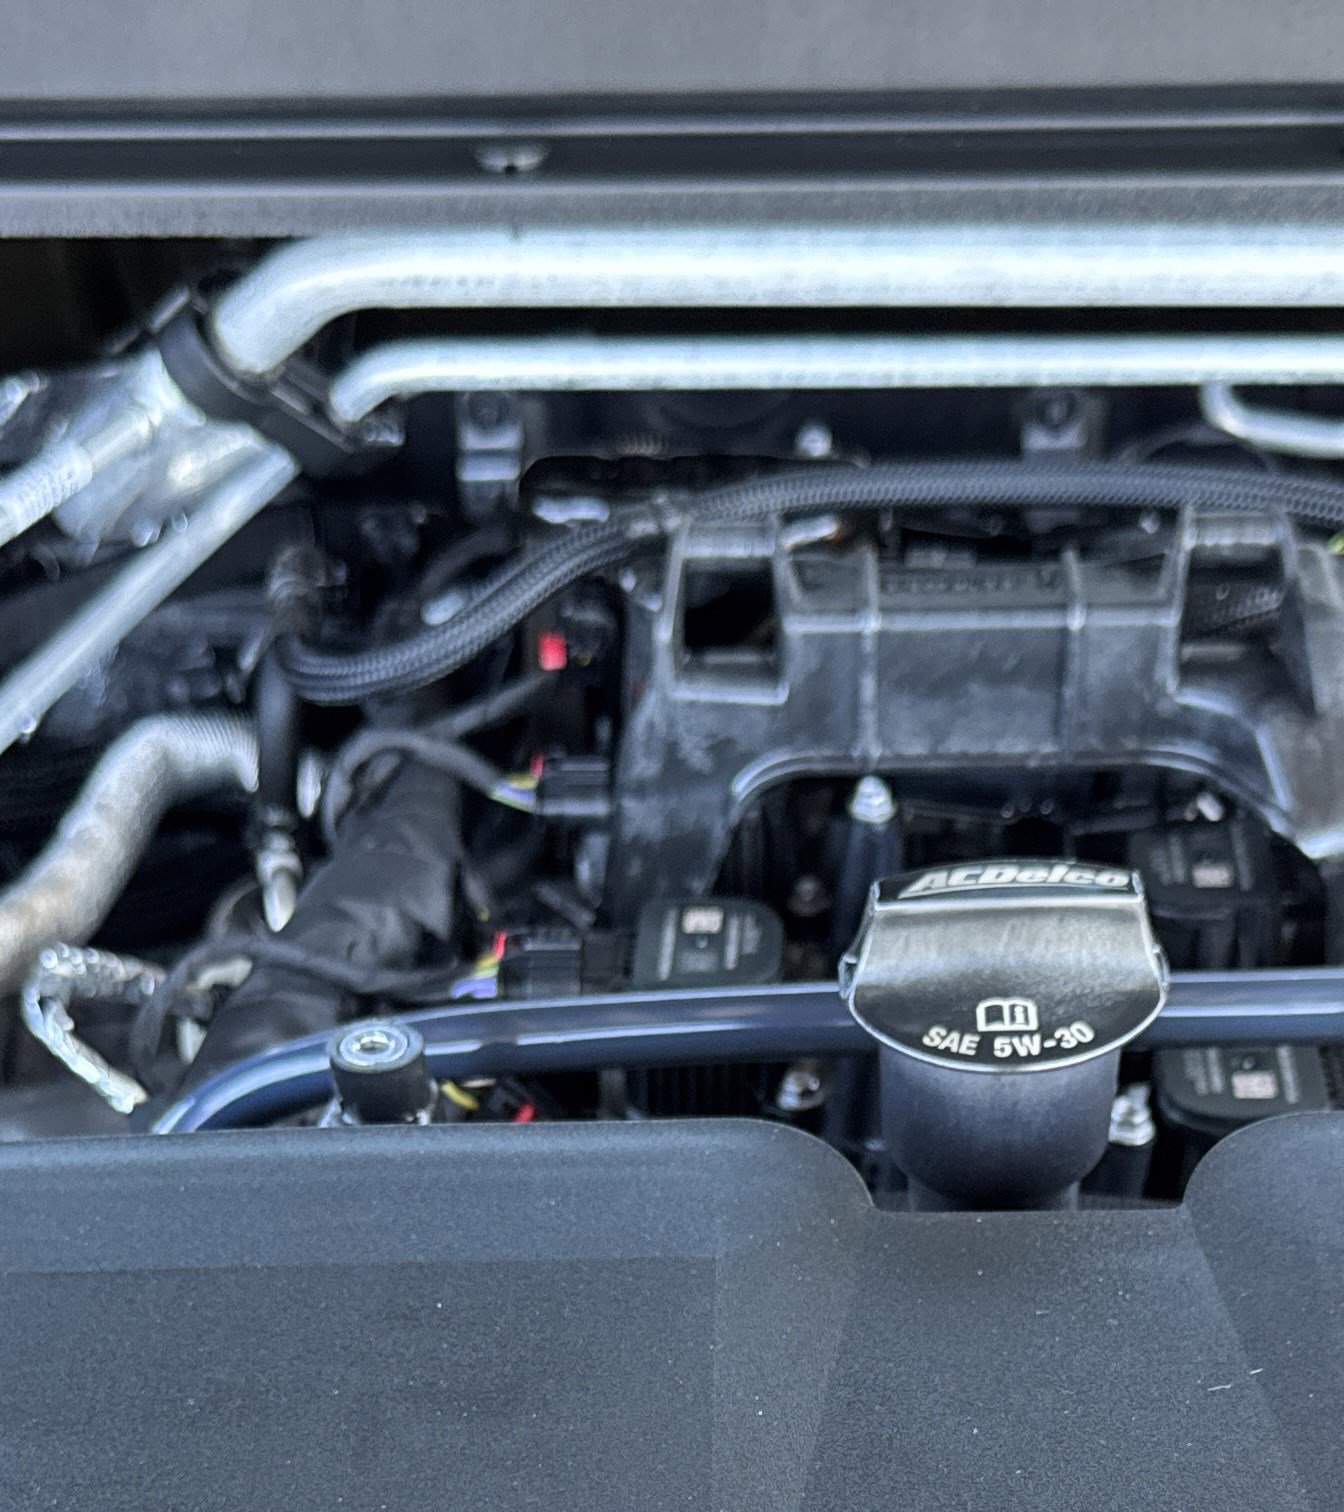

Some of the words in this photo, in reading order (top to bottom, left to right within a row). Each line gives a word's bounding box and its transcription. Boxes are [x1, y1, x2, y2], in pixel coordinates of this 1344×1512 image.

[906, 864, 1130, 896] ACDelco
[921, 1025, 981, 1056] SAE
[992, 1021, 1095, 1058] 5W-30
